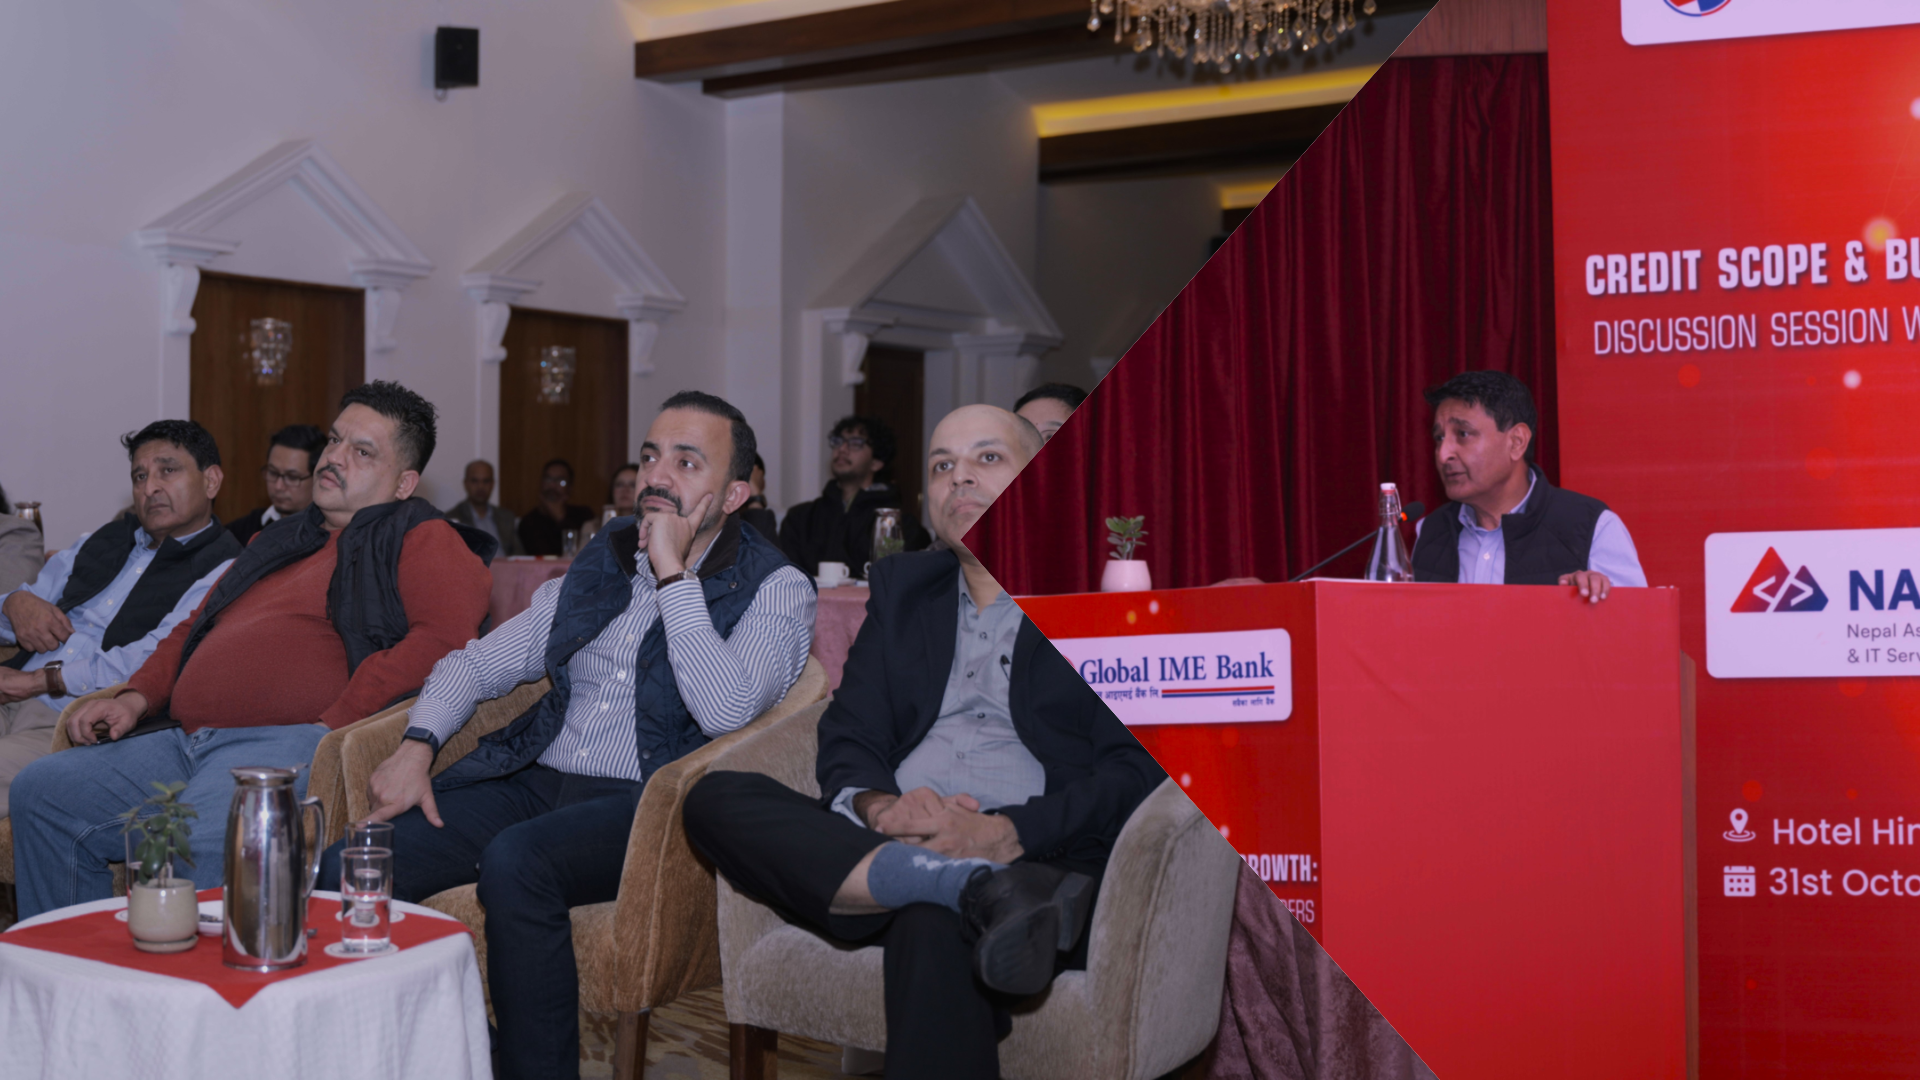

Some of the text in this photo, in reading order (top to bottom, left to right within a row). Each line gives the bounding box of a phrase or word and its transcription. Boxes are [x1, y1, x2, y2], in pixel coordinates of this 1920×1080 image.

[1586, 250, 1701, 295] CREDIT
[1718, 243, 1828, 289] SCOPE
[1845, 240, 1868, 282] &
[1594, 313, 1756, 355] DISCUSSION
[1771, 307, 1888, 347] SESSION
[1848, 568, 1920, 611] NA
[1847, 622, 1897, 641] Nepal
[1079, 651, 1275, 685] Global IME Bank
[1847, 648, 1860, 664] &
[1865, 648, 1881, 663] IT
[1773, 817, 1861, 846] Hotel
[1240, 853, 1318, 882] ROWTH:
[1769, 867, 1920, 897] 31st Octo
